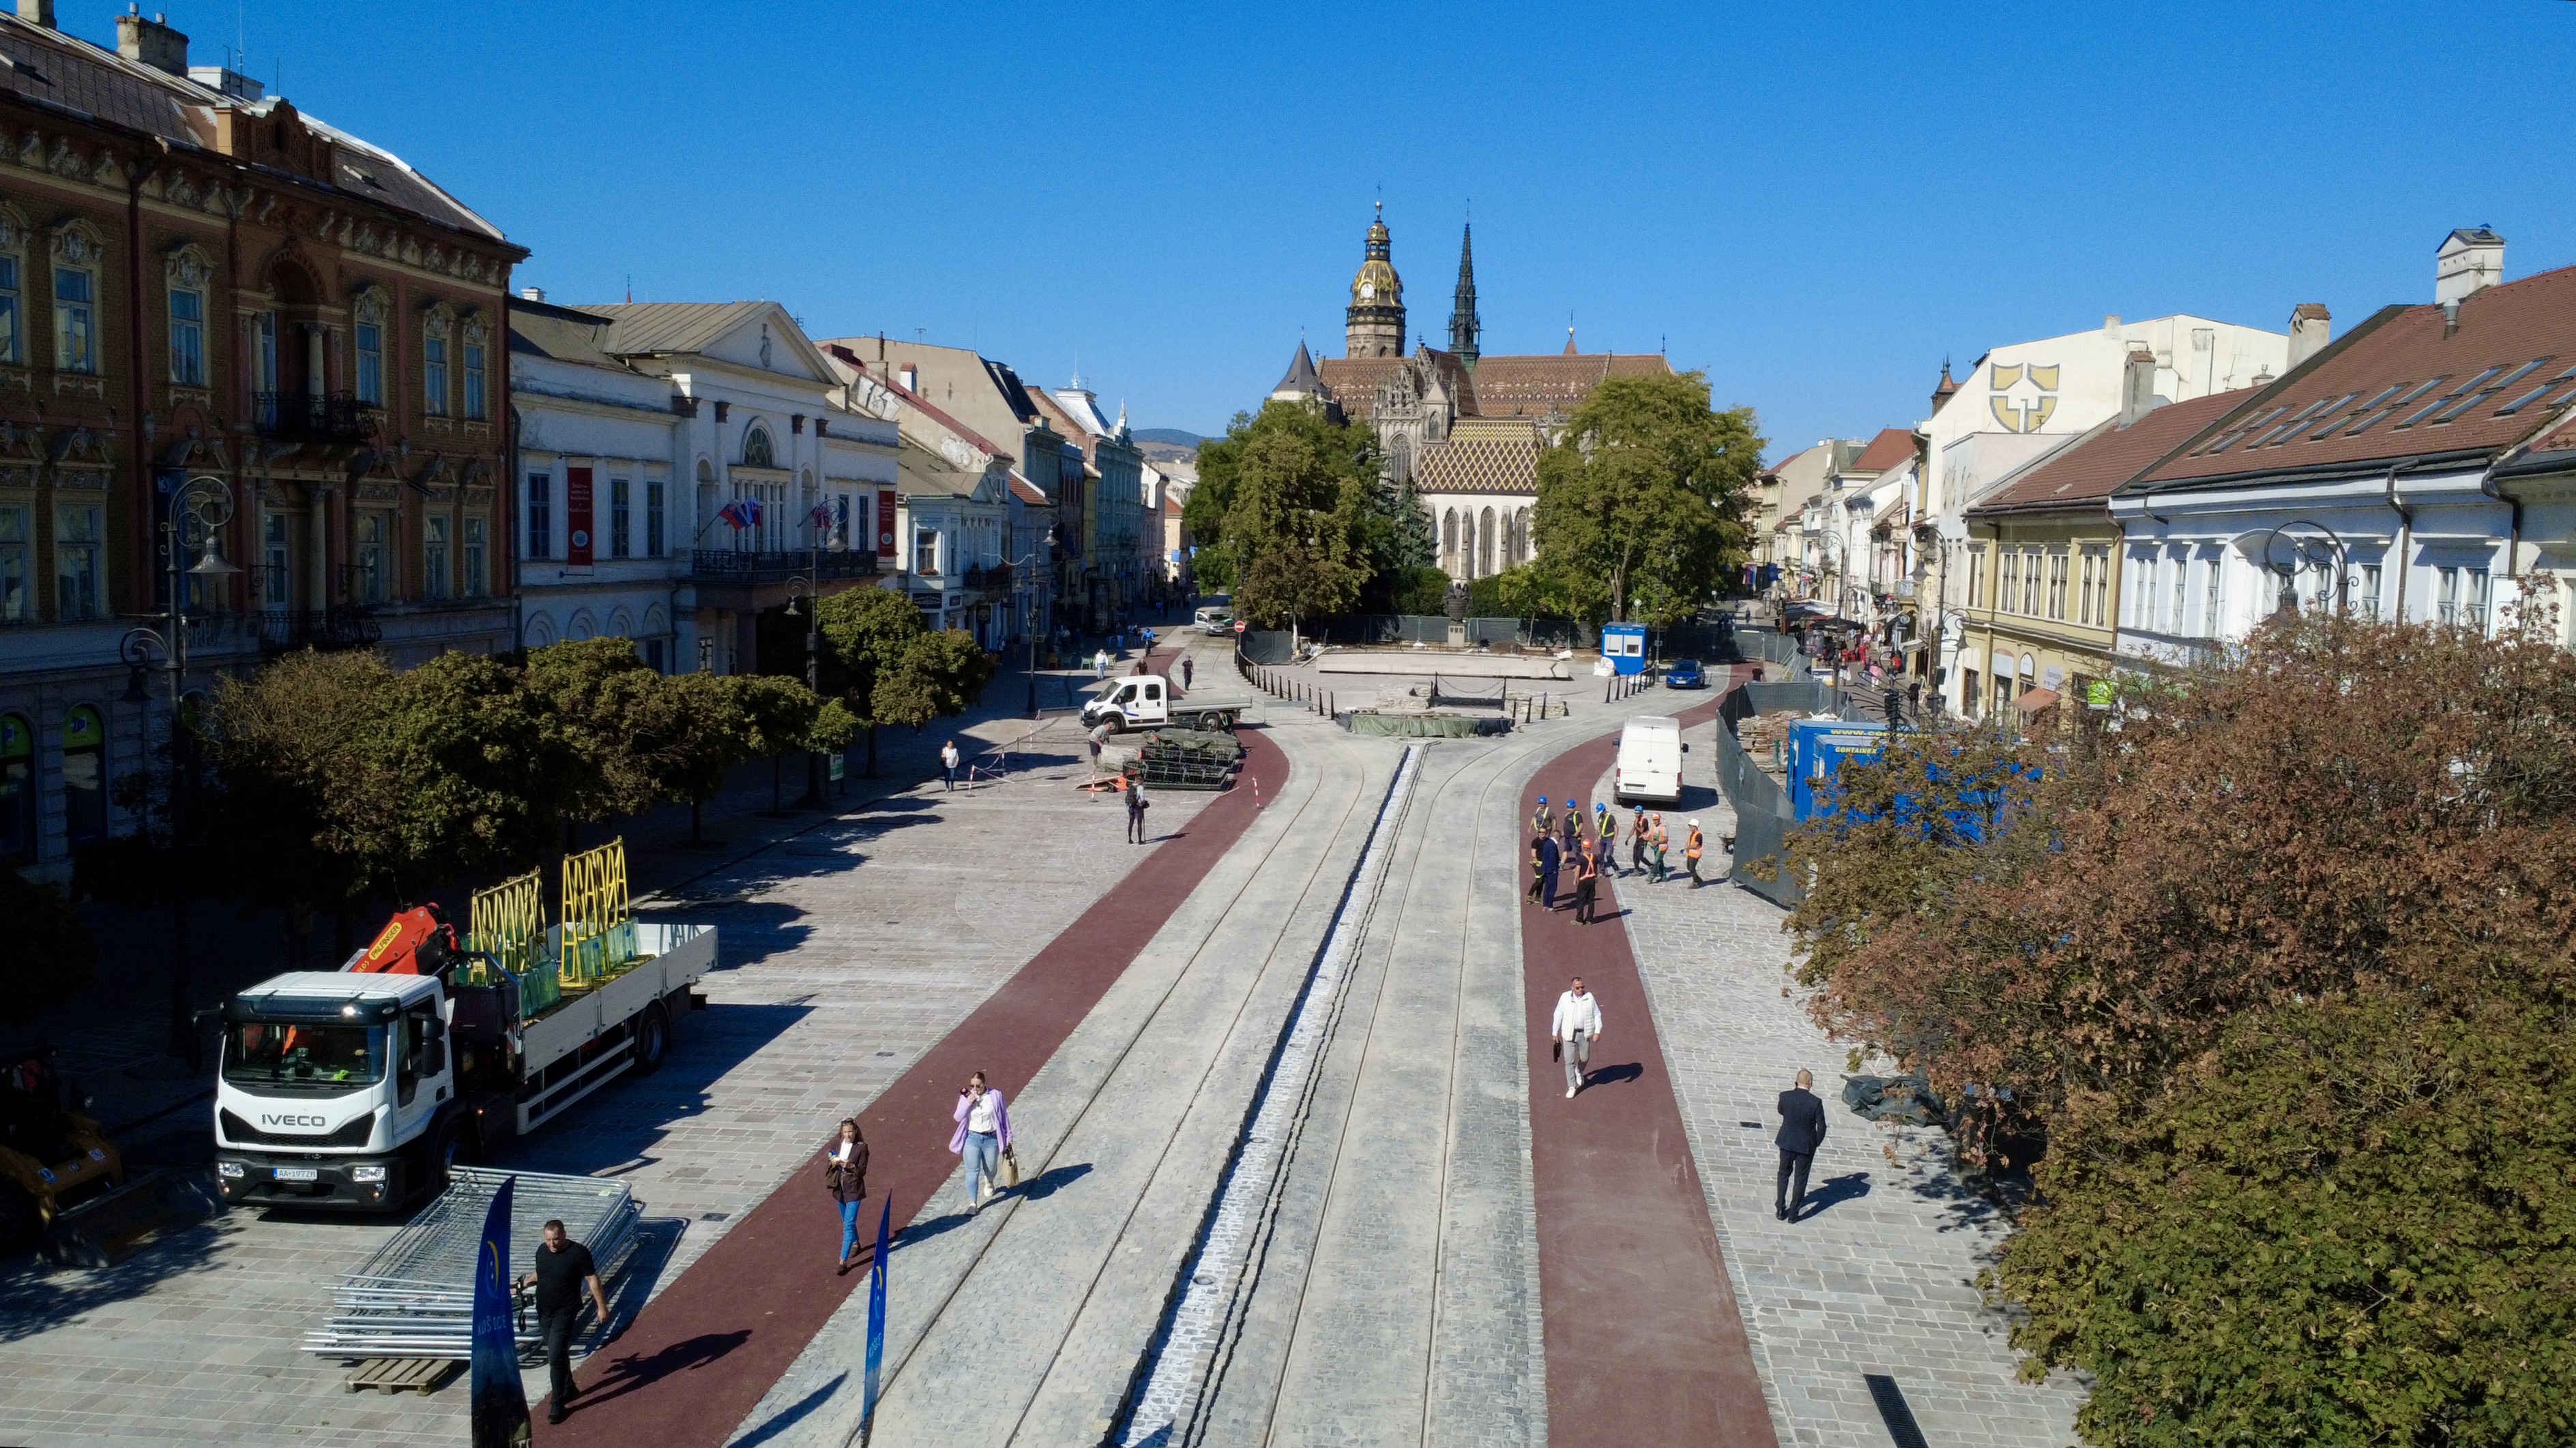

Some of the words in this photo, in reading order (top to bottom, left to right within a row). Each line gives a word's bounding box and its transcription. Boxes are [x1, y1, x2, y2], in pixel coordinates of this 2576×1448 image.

[1834, 746, 1877, 754] CONTAINEX
[370, 924, 400, 958] PALFINGER
[261, 1114, 326, 1127] IVECO
[478, 1314, 507, 1336] KOŠICE
